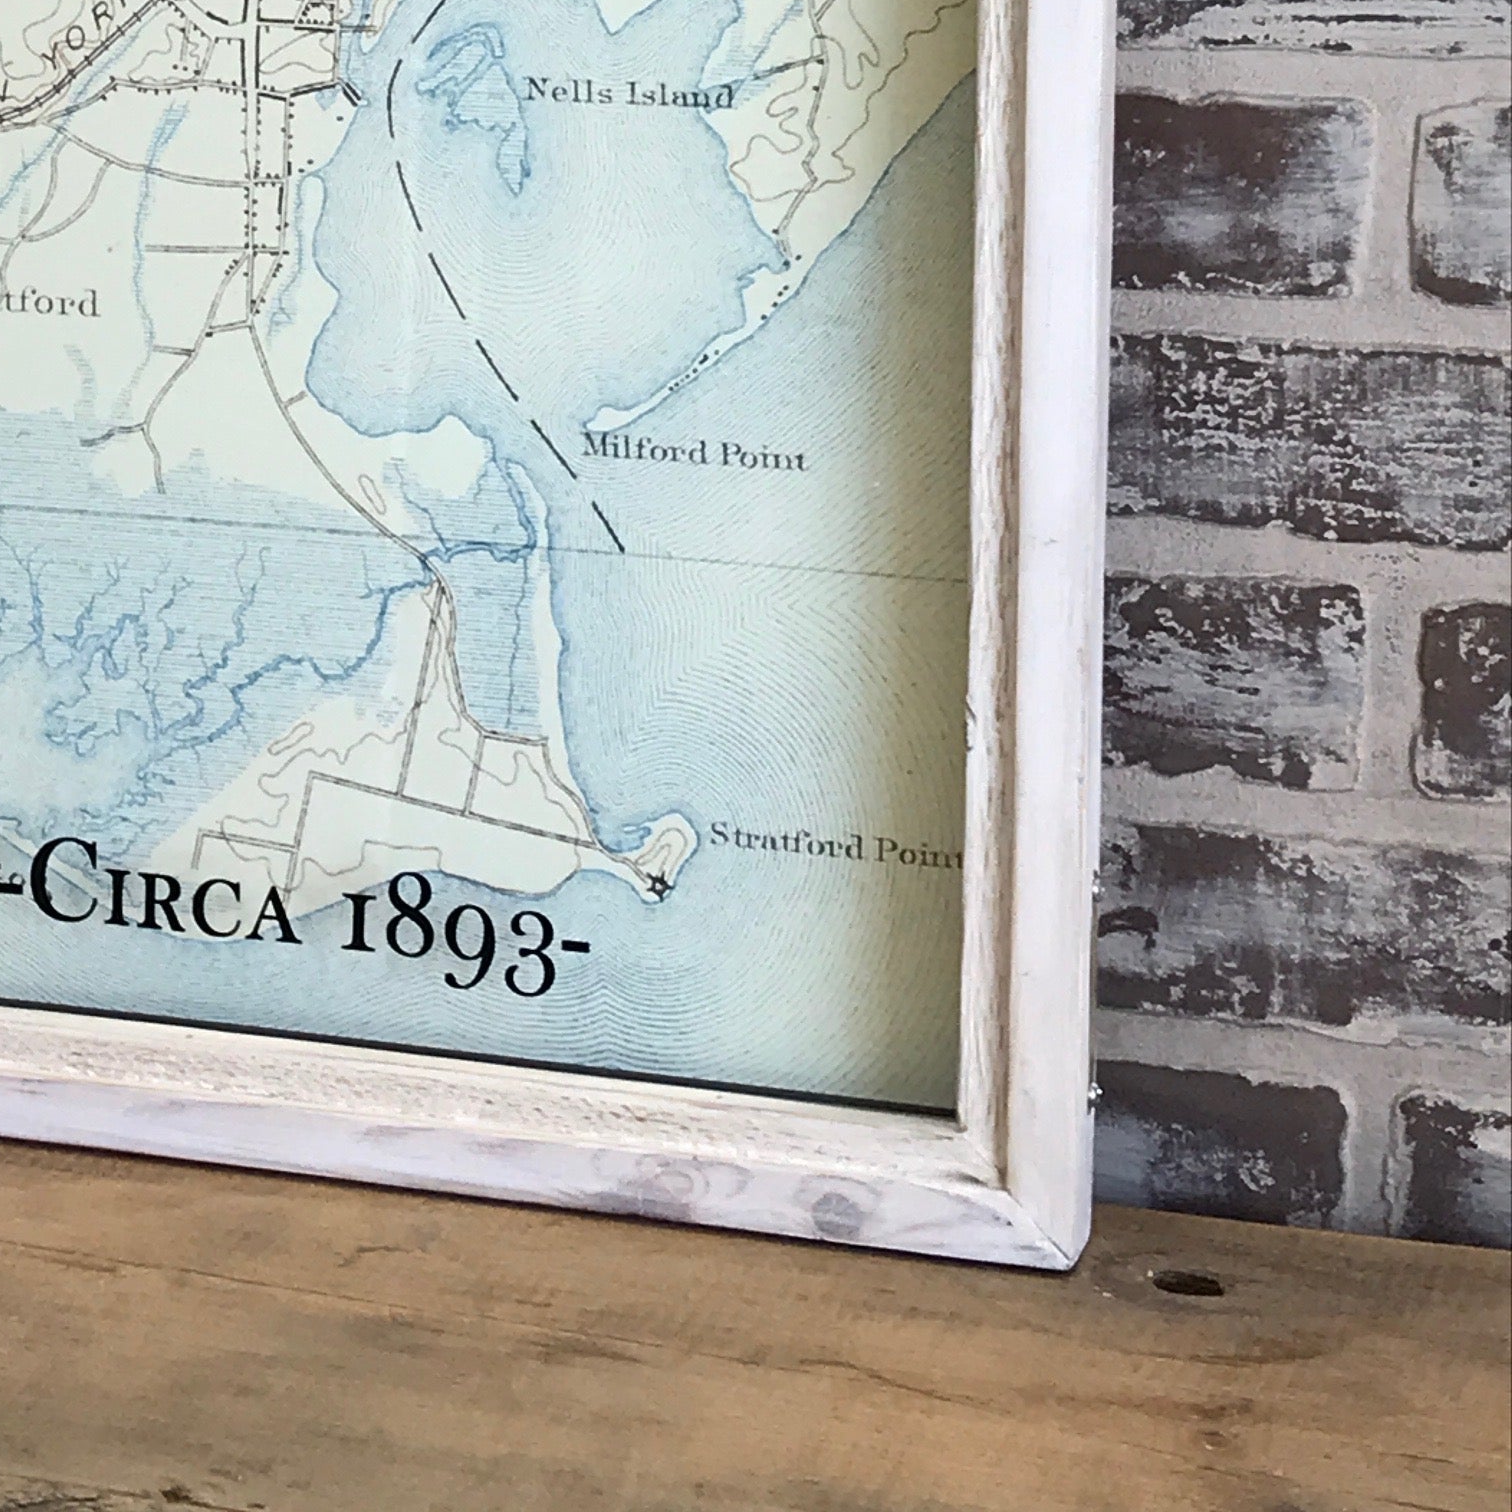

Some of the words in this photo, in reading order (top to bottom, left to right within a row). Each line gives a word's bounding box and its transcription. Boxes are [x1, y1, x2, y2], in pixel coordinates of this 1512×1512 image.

[523, 76, 613, 104] Nells
[625, 81, 738, 109] Island
[581, 431, 708, 465] Milford
[721, 442, 809, 472] Point
[710, 821, 865, 861] Stratford
[873, 837, 963, 870] Point
